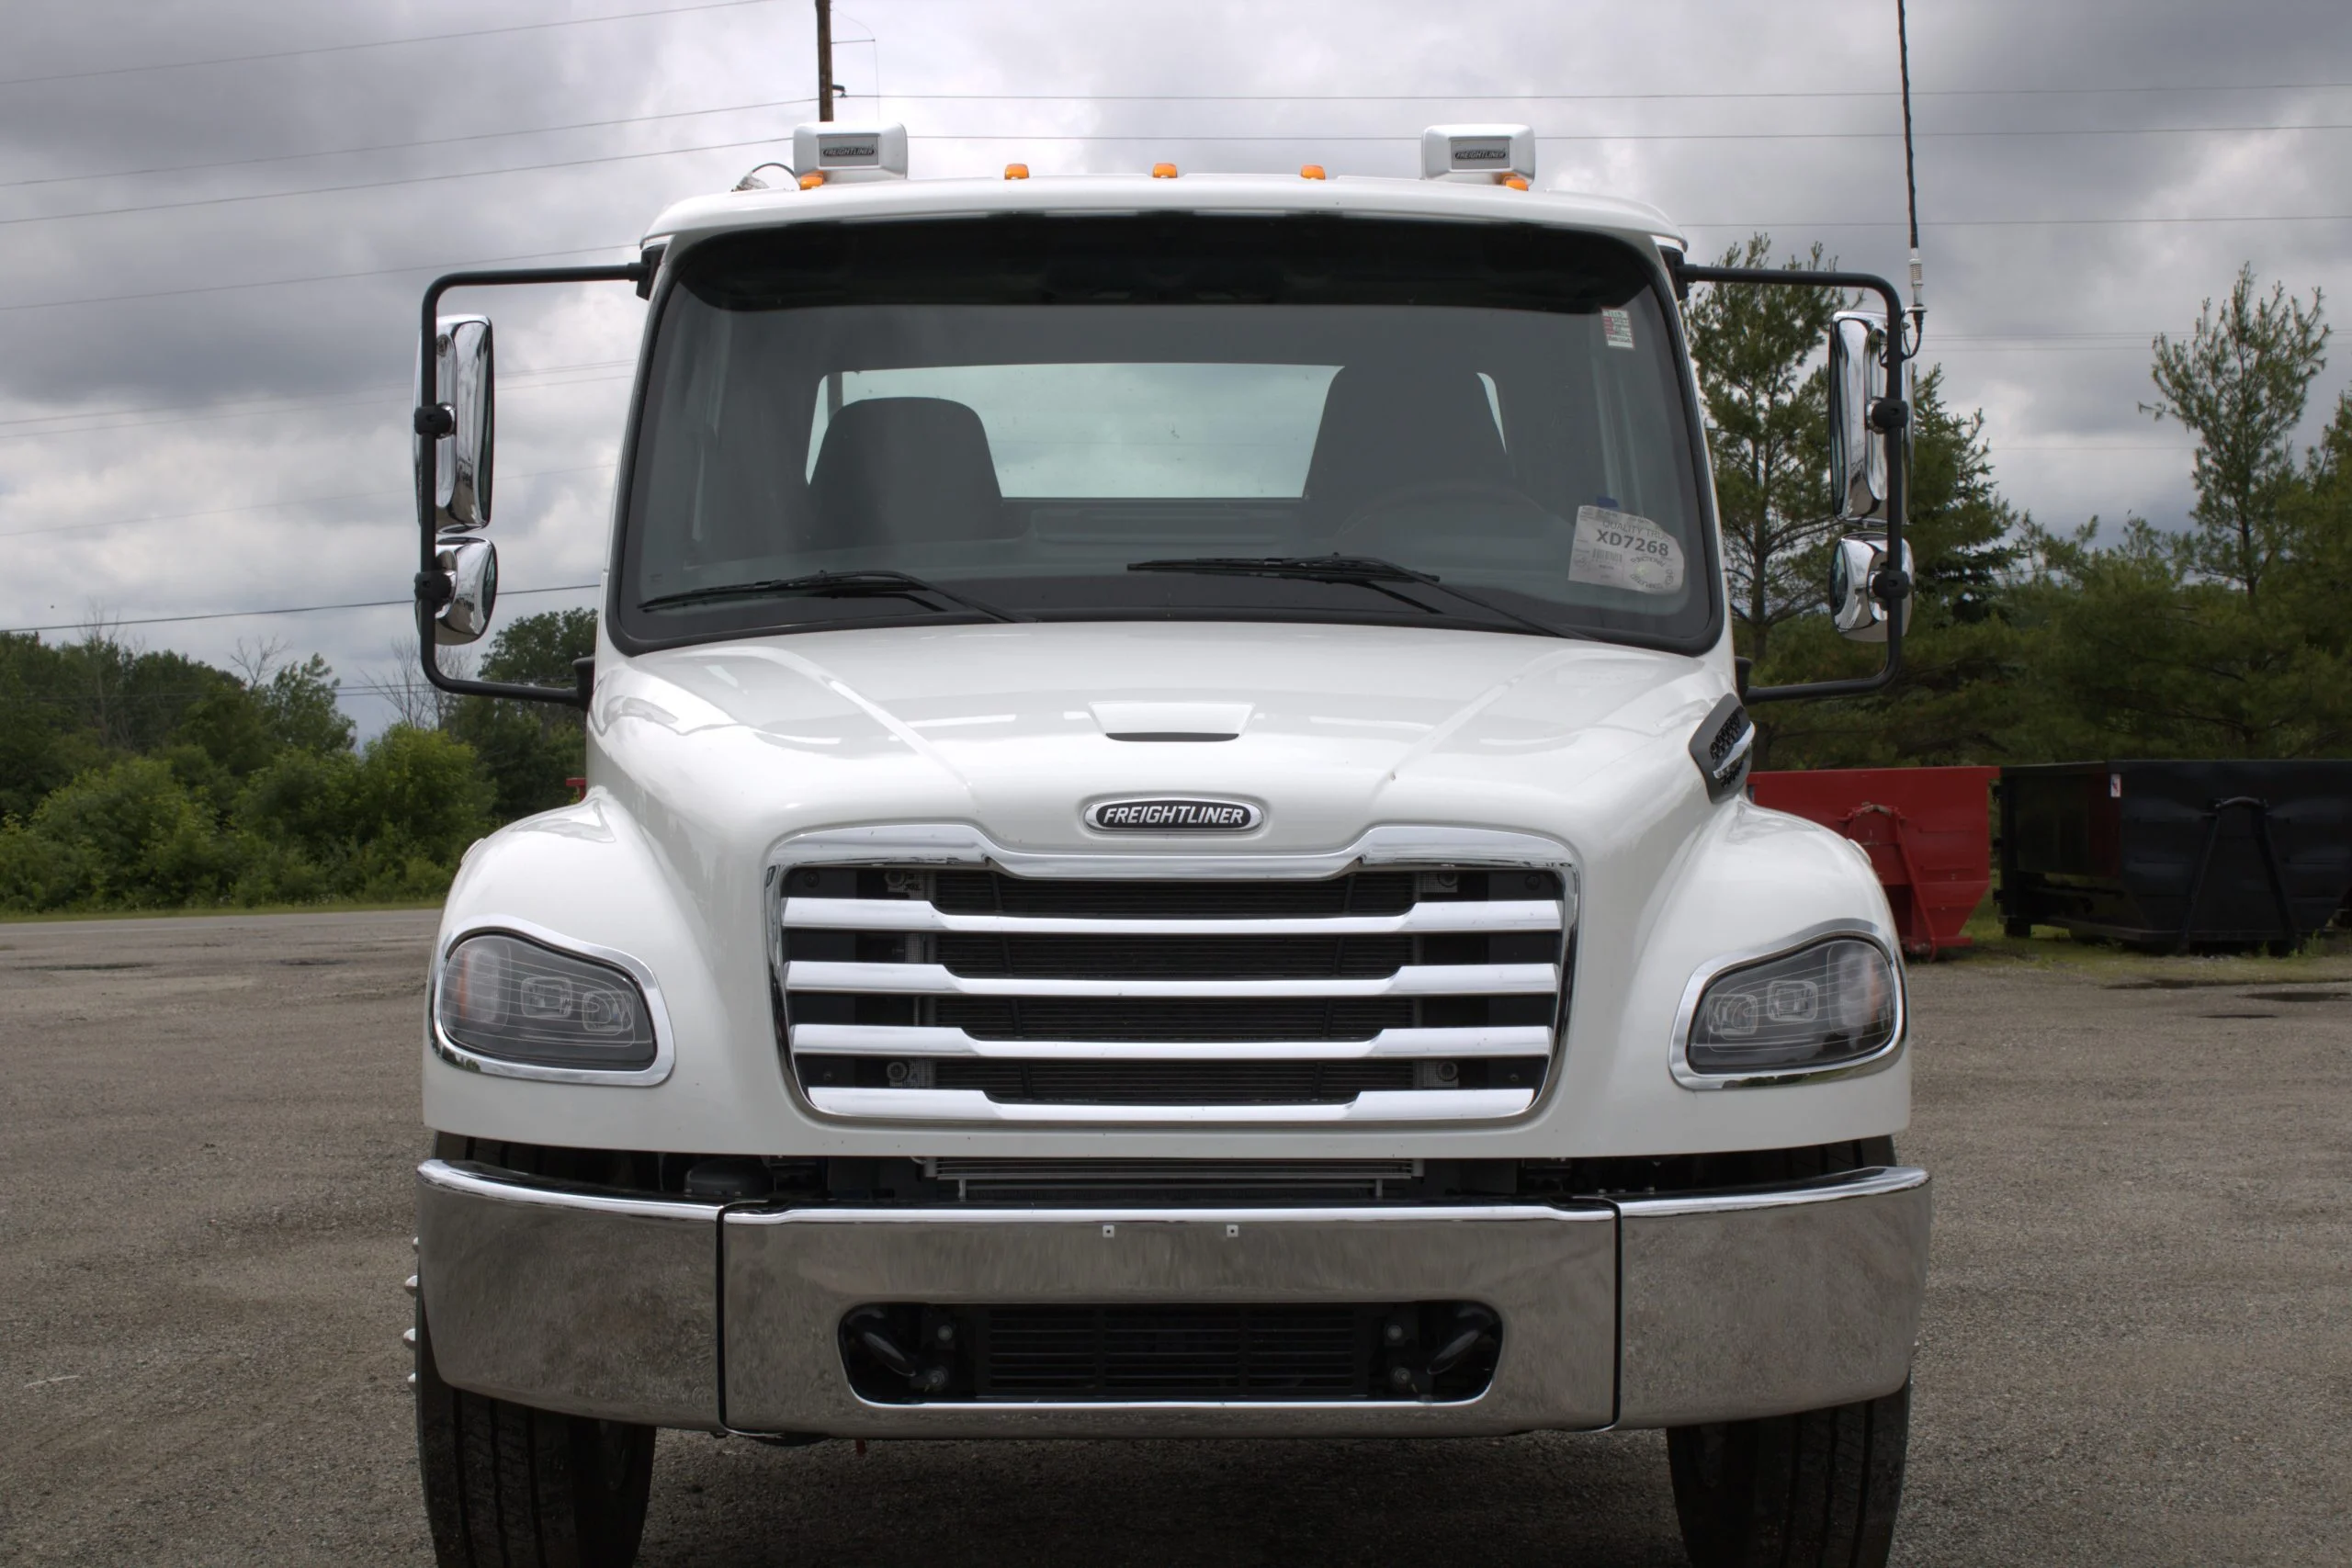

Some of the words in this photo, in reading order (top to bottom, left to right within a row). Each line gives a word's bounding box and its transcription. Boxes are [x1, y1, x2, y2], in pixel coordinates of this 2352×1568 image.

[1456, 149, 1506, 159] FREIGHTLINER
[1596, 529, 1668, 557] XD7268
[1102, 806, 1243, 824] FREIGHTLINER
